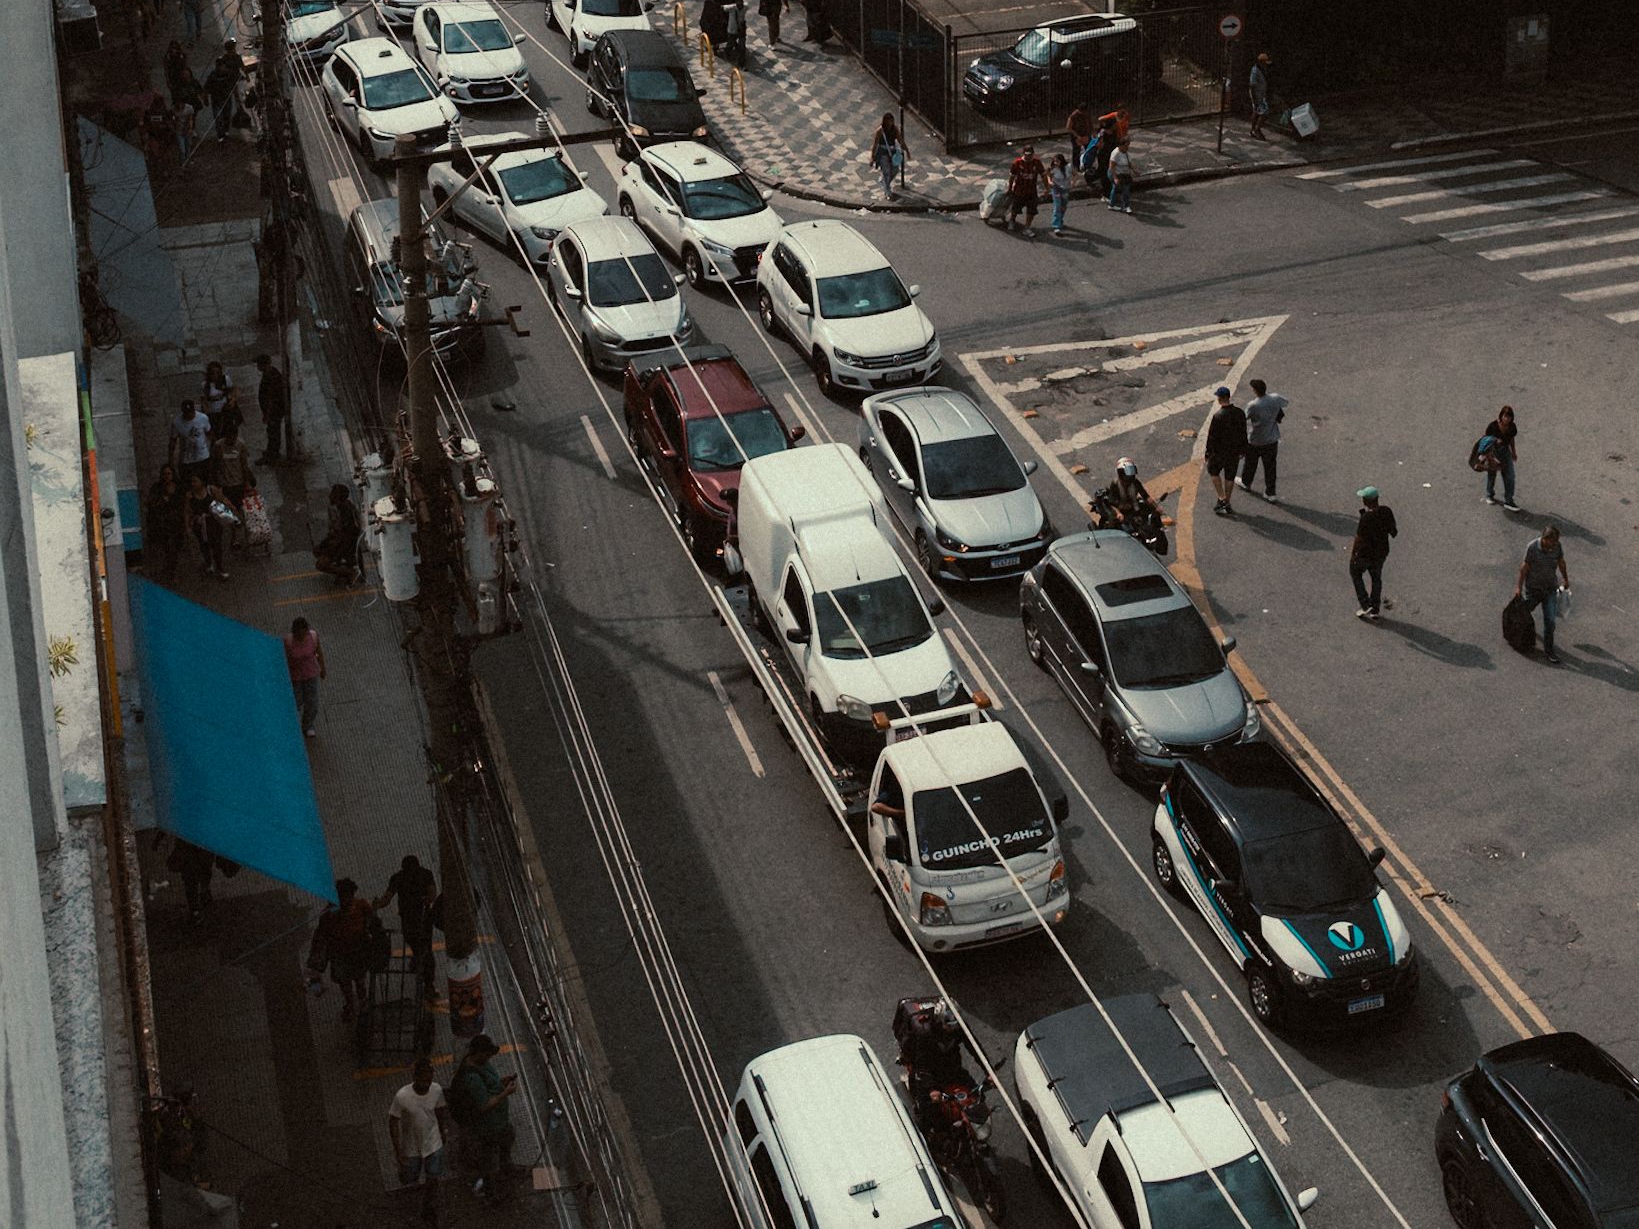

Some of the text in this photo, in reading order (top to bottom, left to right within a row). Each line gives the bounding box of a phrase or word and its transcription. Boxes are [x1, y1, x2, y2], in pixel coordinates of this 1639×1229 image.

[932, 828, 1043, 862] GUINCHO 24Hrs
[1338, 947, 1376, 962] VERGATI
[853, 1179, 876, 1192] TAXI
